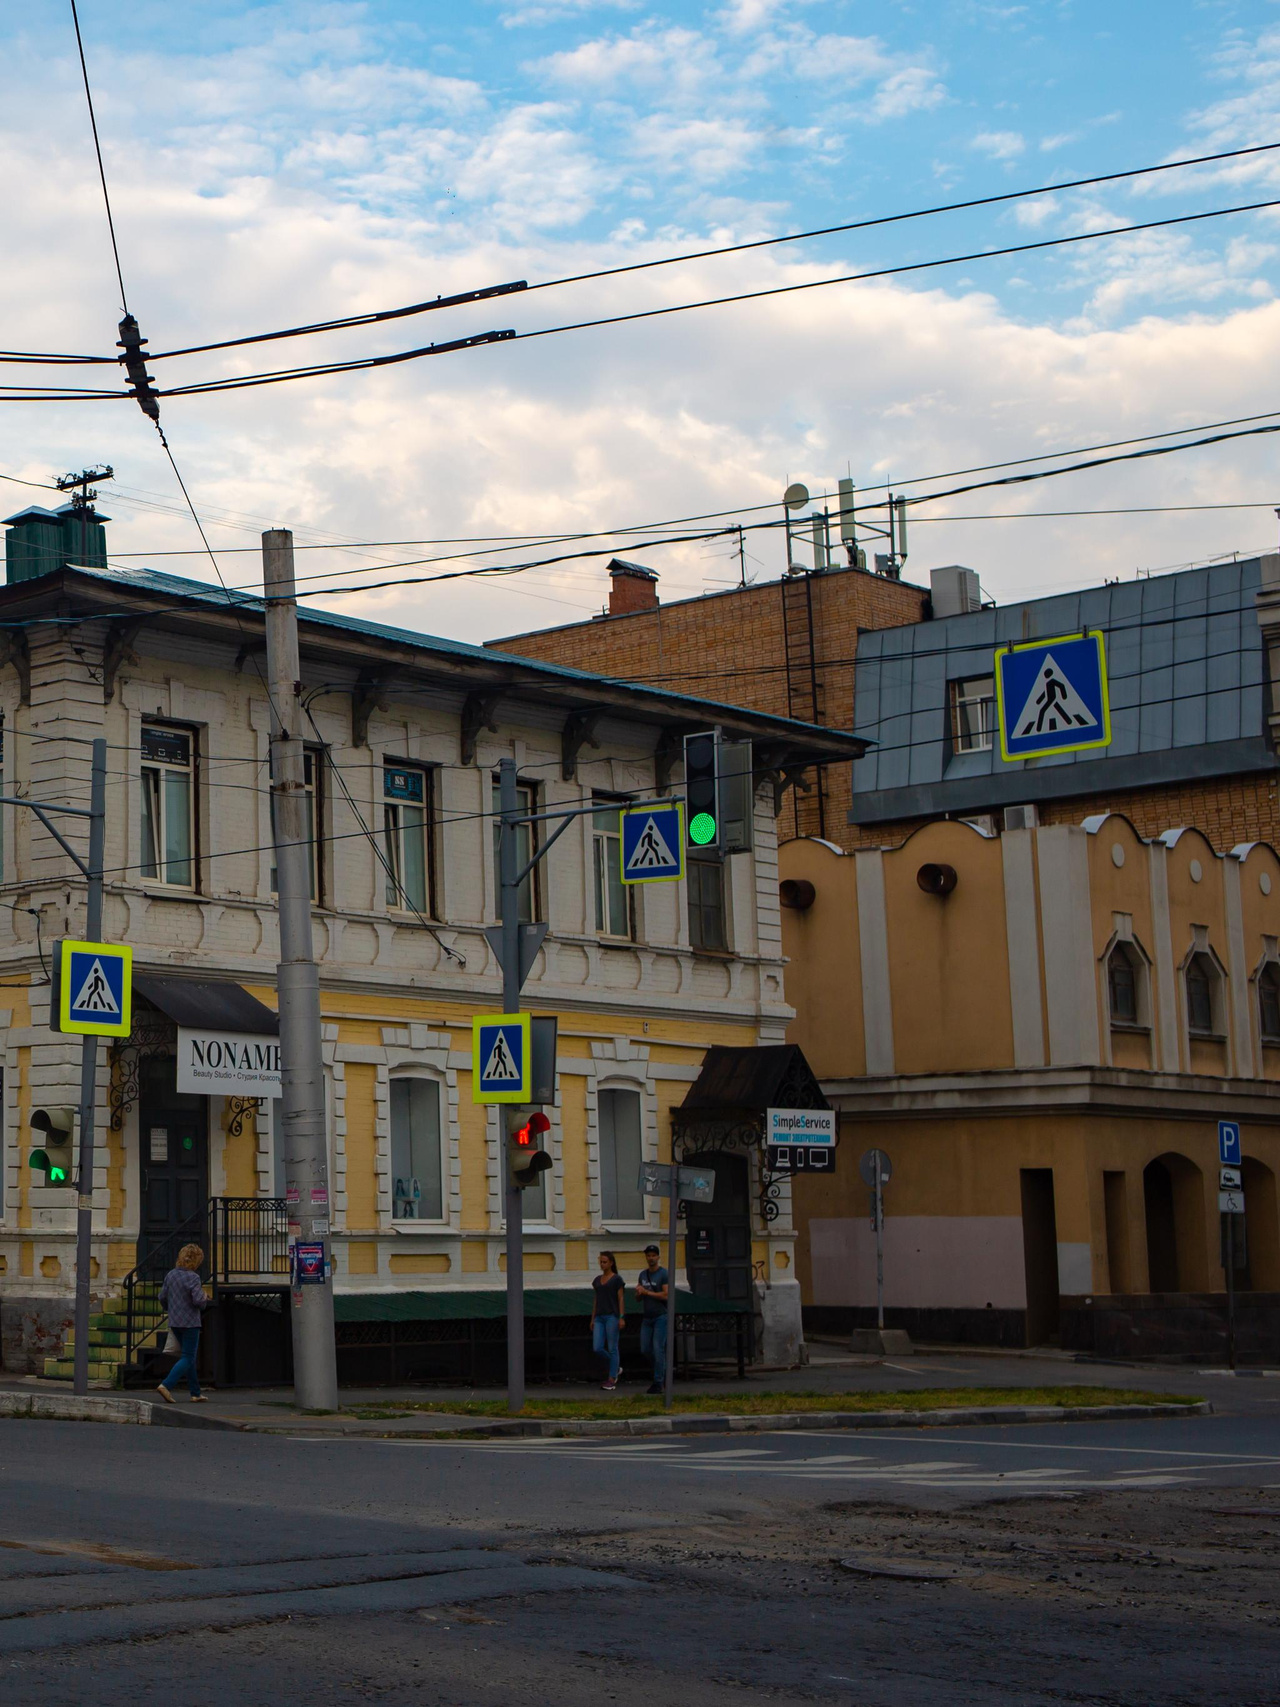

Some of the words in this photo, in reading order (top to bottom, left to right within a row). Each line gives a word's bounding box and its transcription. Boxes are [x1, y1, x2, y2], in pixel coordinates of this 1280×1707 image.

[193, 1069, 213, 1080] Beauty
[214, 1071, 232, 1079] Studio
[237, 1072, 258, 1082] Студия
[773, 1114, 830, 1130] SimpleService
[1223, 1126, 1235, 1158] P
